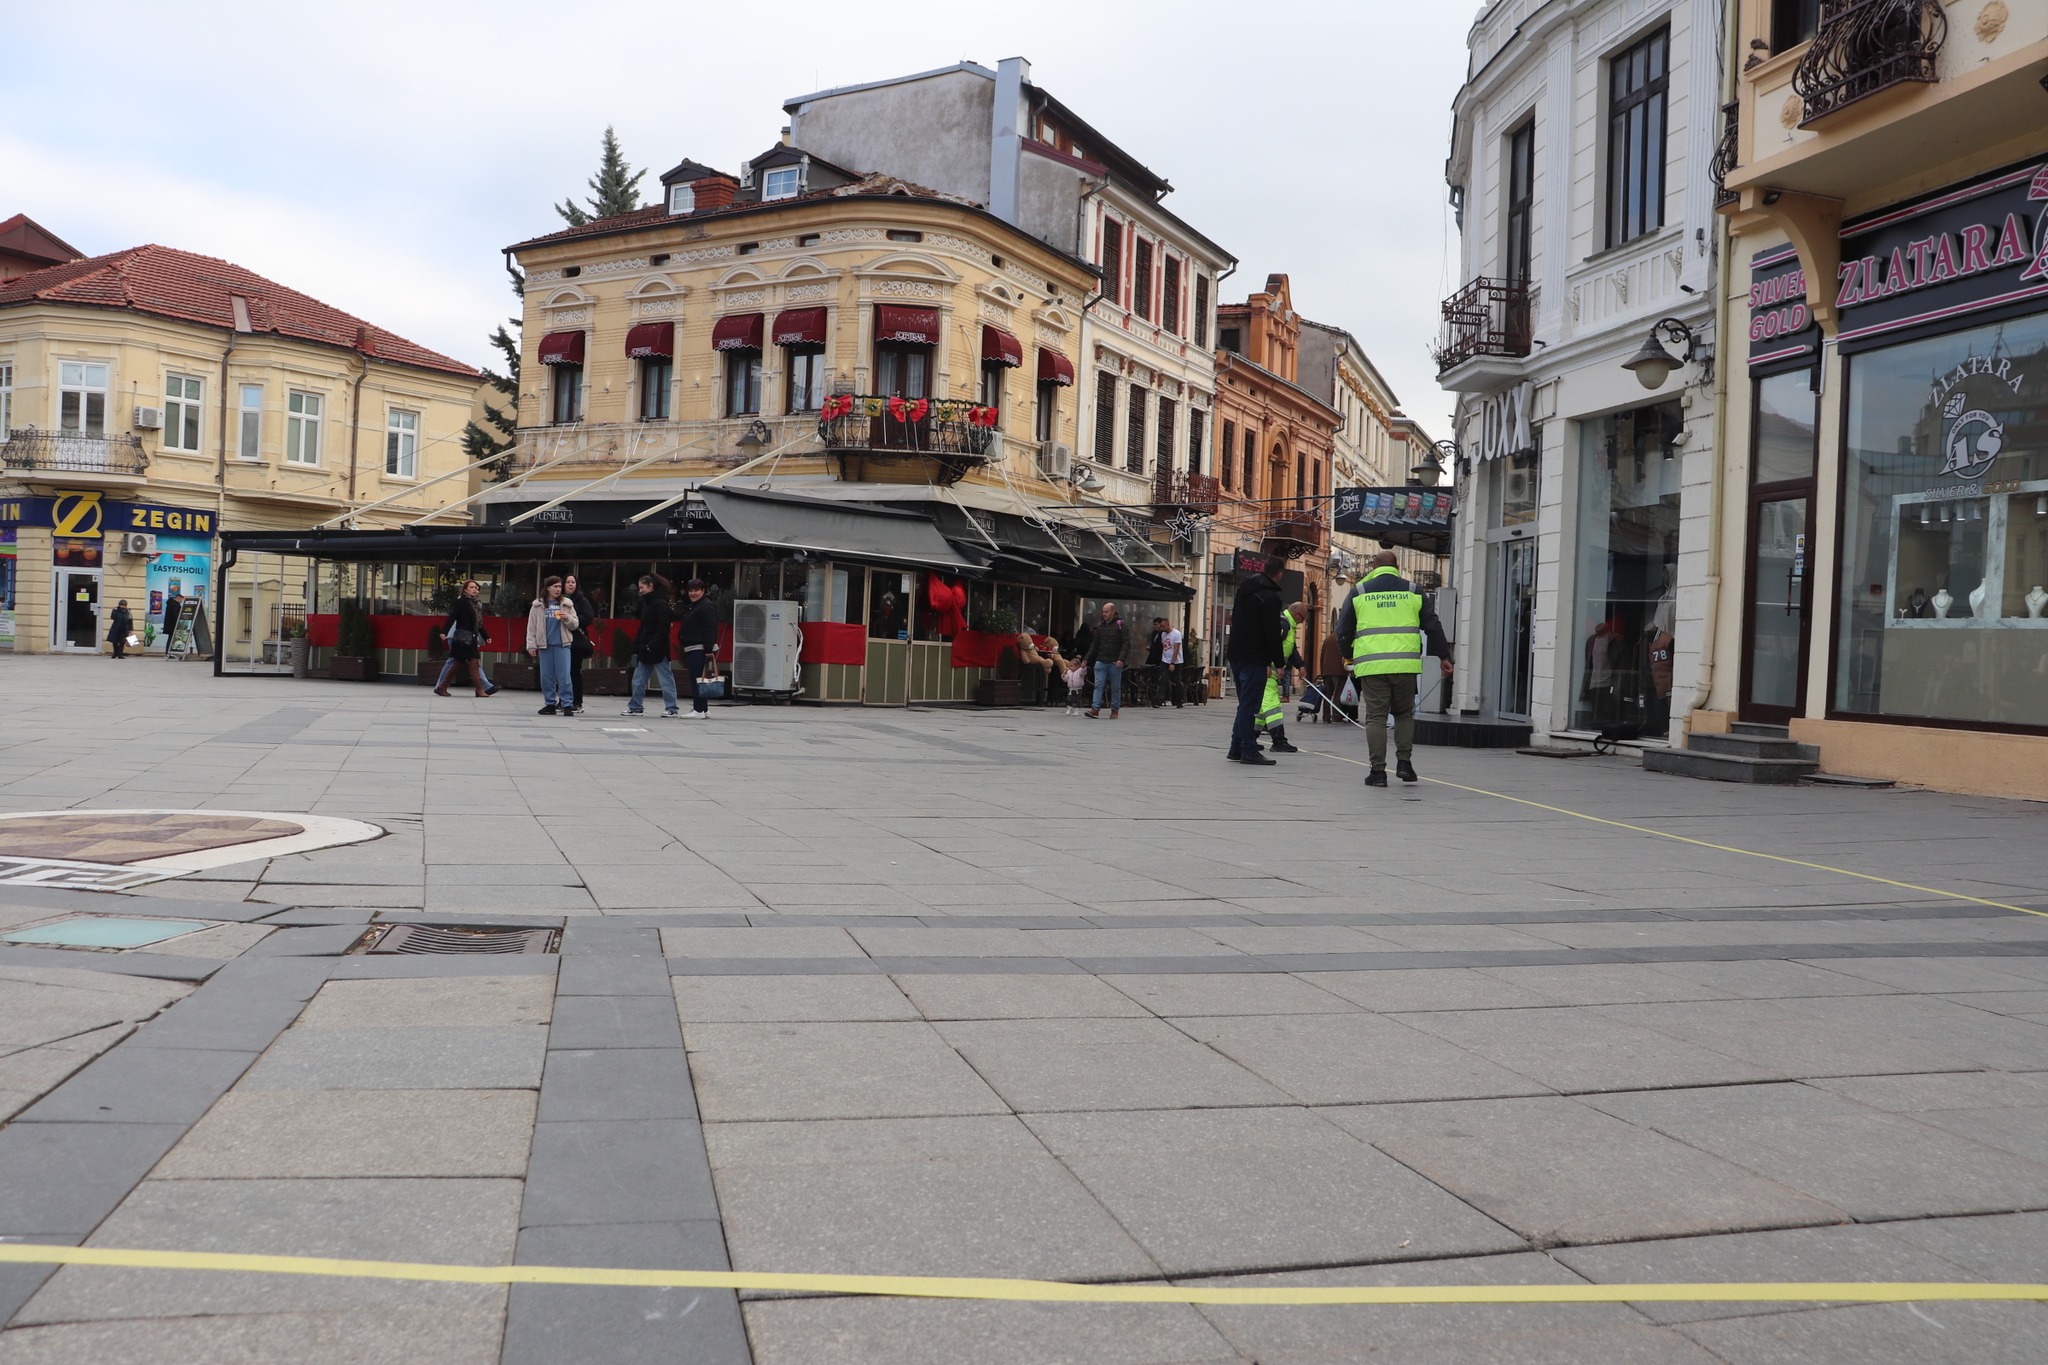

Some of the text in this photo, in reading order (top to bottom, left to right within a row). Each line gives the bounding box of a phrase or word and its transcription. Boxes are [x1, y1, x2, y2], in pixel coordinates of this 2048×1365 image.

[1836, 212, 2026, 309] ZLATARA
[1748, 268, 1807, 310] SILVER
[1749, 304, 1806, 342] GOLD
[1928, 354, 2024, 409] ZLATARA
[1470, 382, 1528, 464] JOXX
[1951, 412, 1990, 434] ONLY FOR YOU
[1939, 422, 2004, 476] AS
[1924, 479, 2021, 501] SILVER & GOLD
[0, 503, 20, 521] IN
[538, 511, 568, 521] CENTRAL
[1341, 502, 1360, 510] OUT
[131, 508, 210, 532] ZEGIN
[1364, 593, 1409, 602] ПАРКИНЗИ
[1652, 650, 1668, 661] 78
